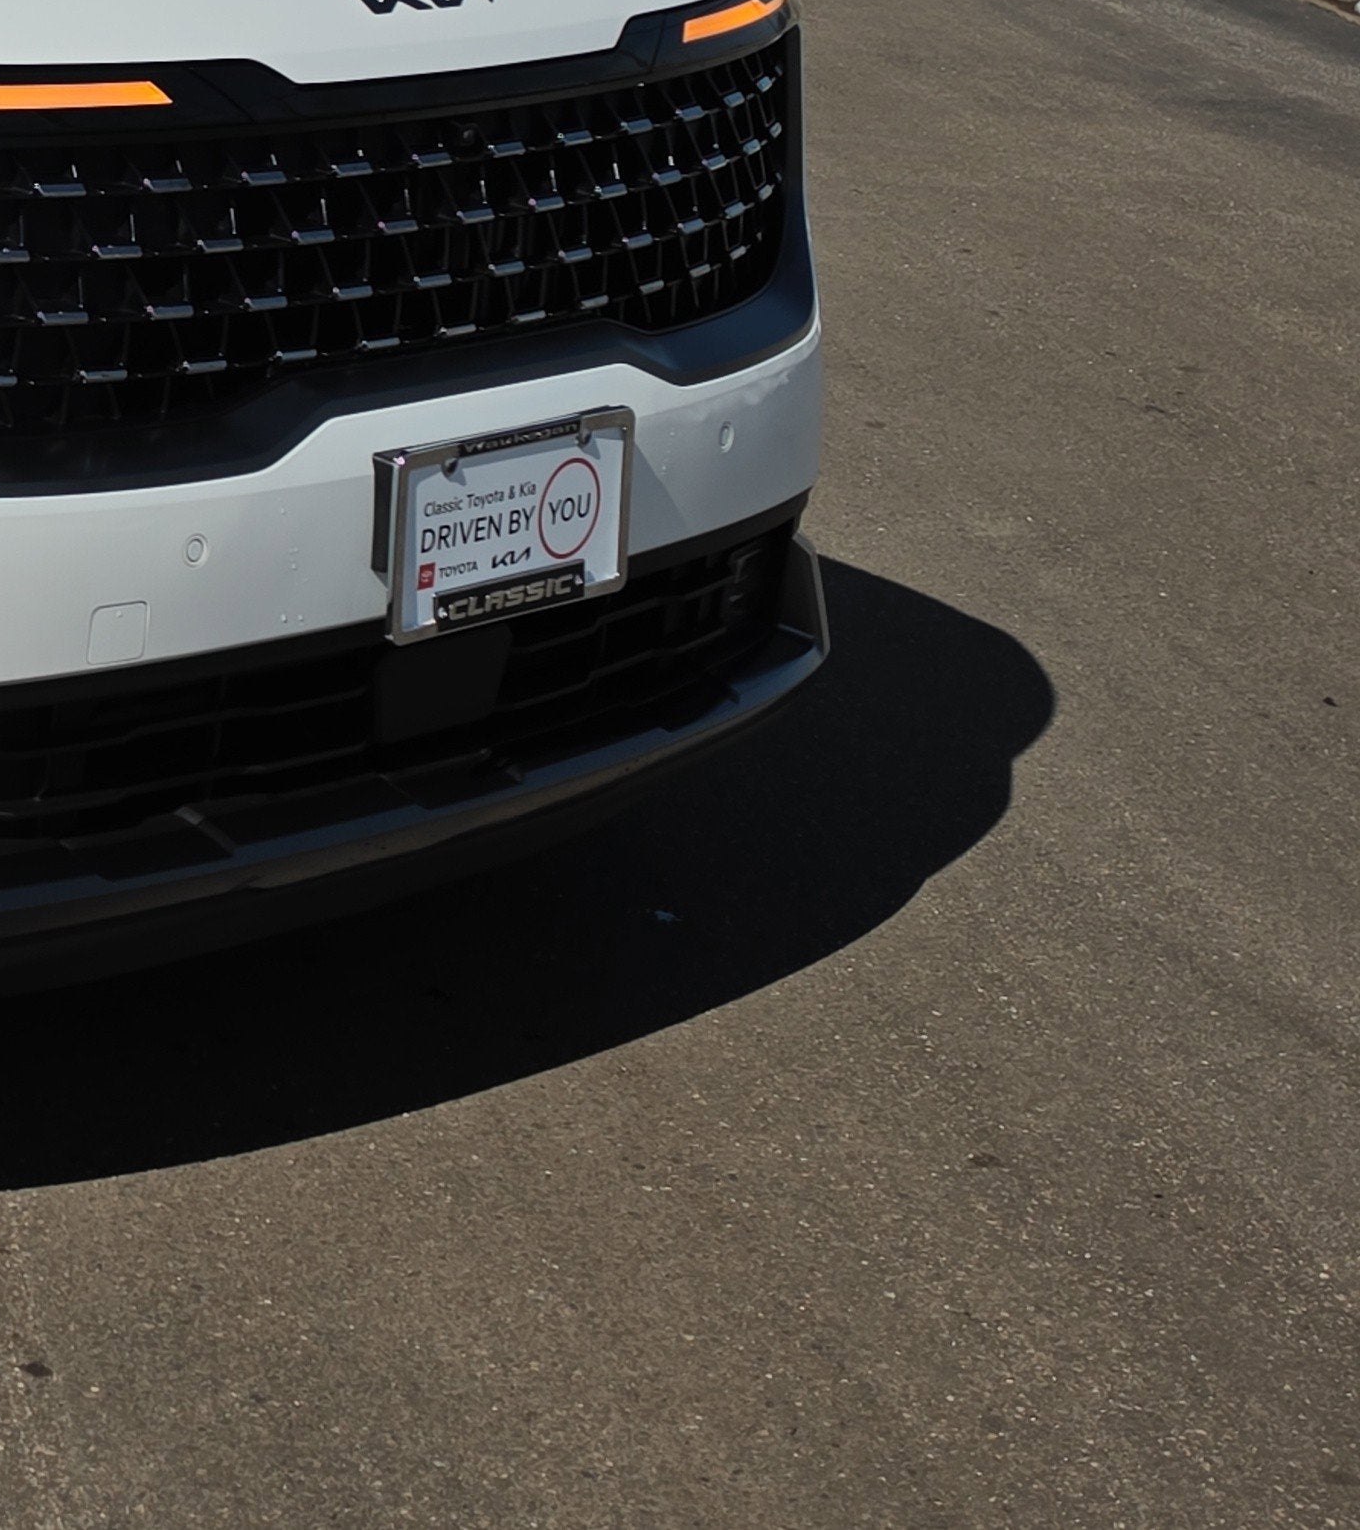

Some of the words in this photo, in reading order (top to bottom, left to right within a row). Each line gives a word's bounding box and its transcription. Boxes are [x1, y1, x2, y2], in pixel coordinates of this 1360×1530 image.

[424, 497, 463, 517] Classic
[467, 490, 504, 509] Toyota
[508, 485, 515, 500] &
[520, 481, 536, 497] Kia
[421, 513, 502, 554] DRIVEN
[509, 505, 536, 535] BY
[548, 492, 591, 525] YOU
[439, 561, 479, 579] TOYOTA
[491, 546, 531, 569] KIA
[448, 573, 573, 620] CLASSIC
